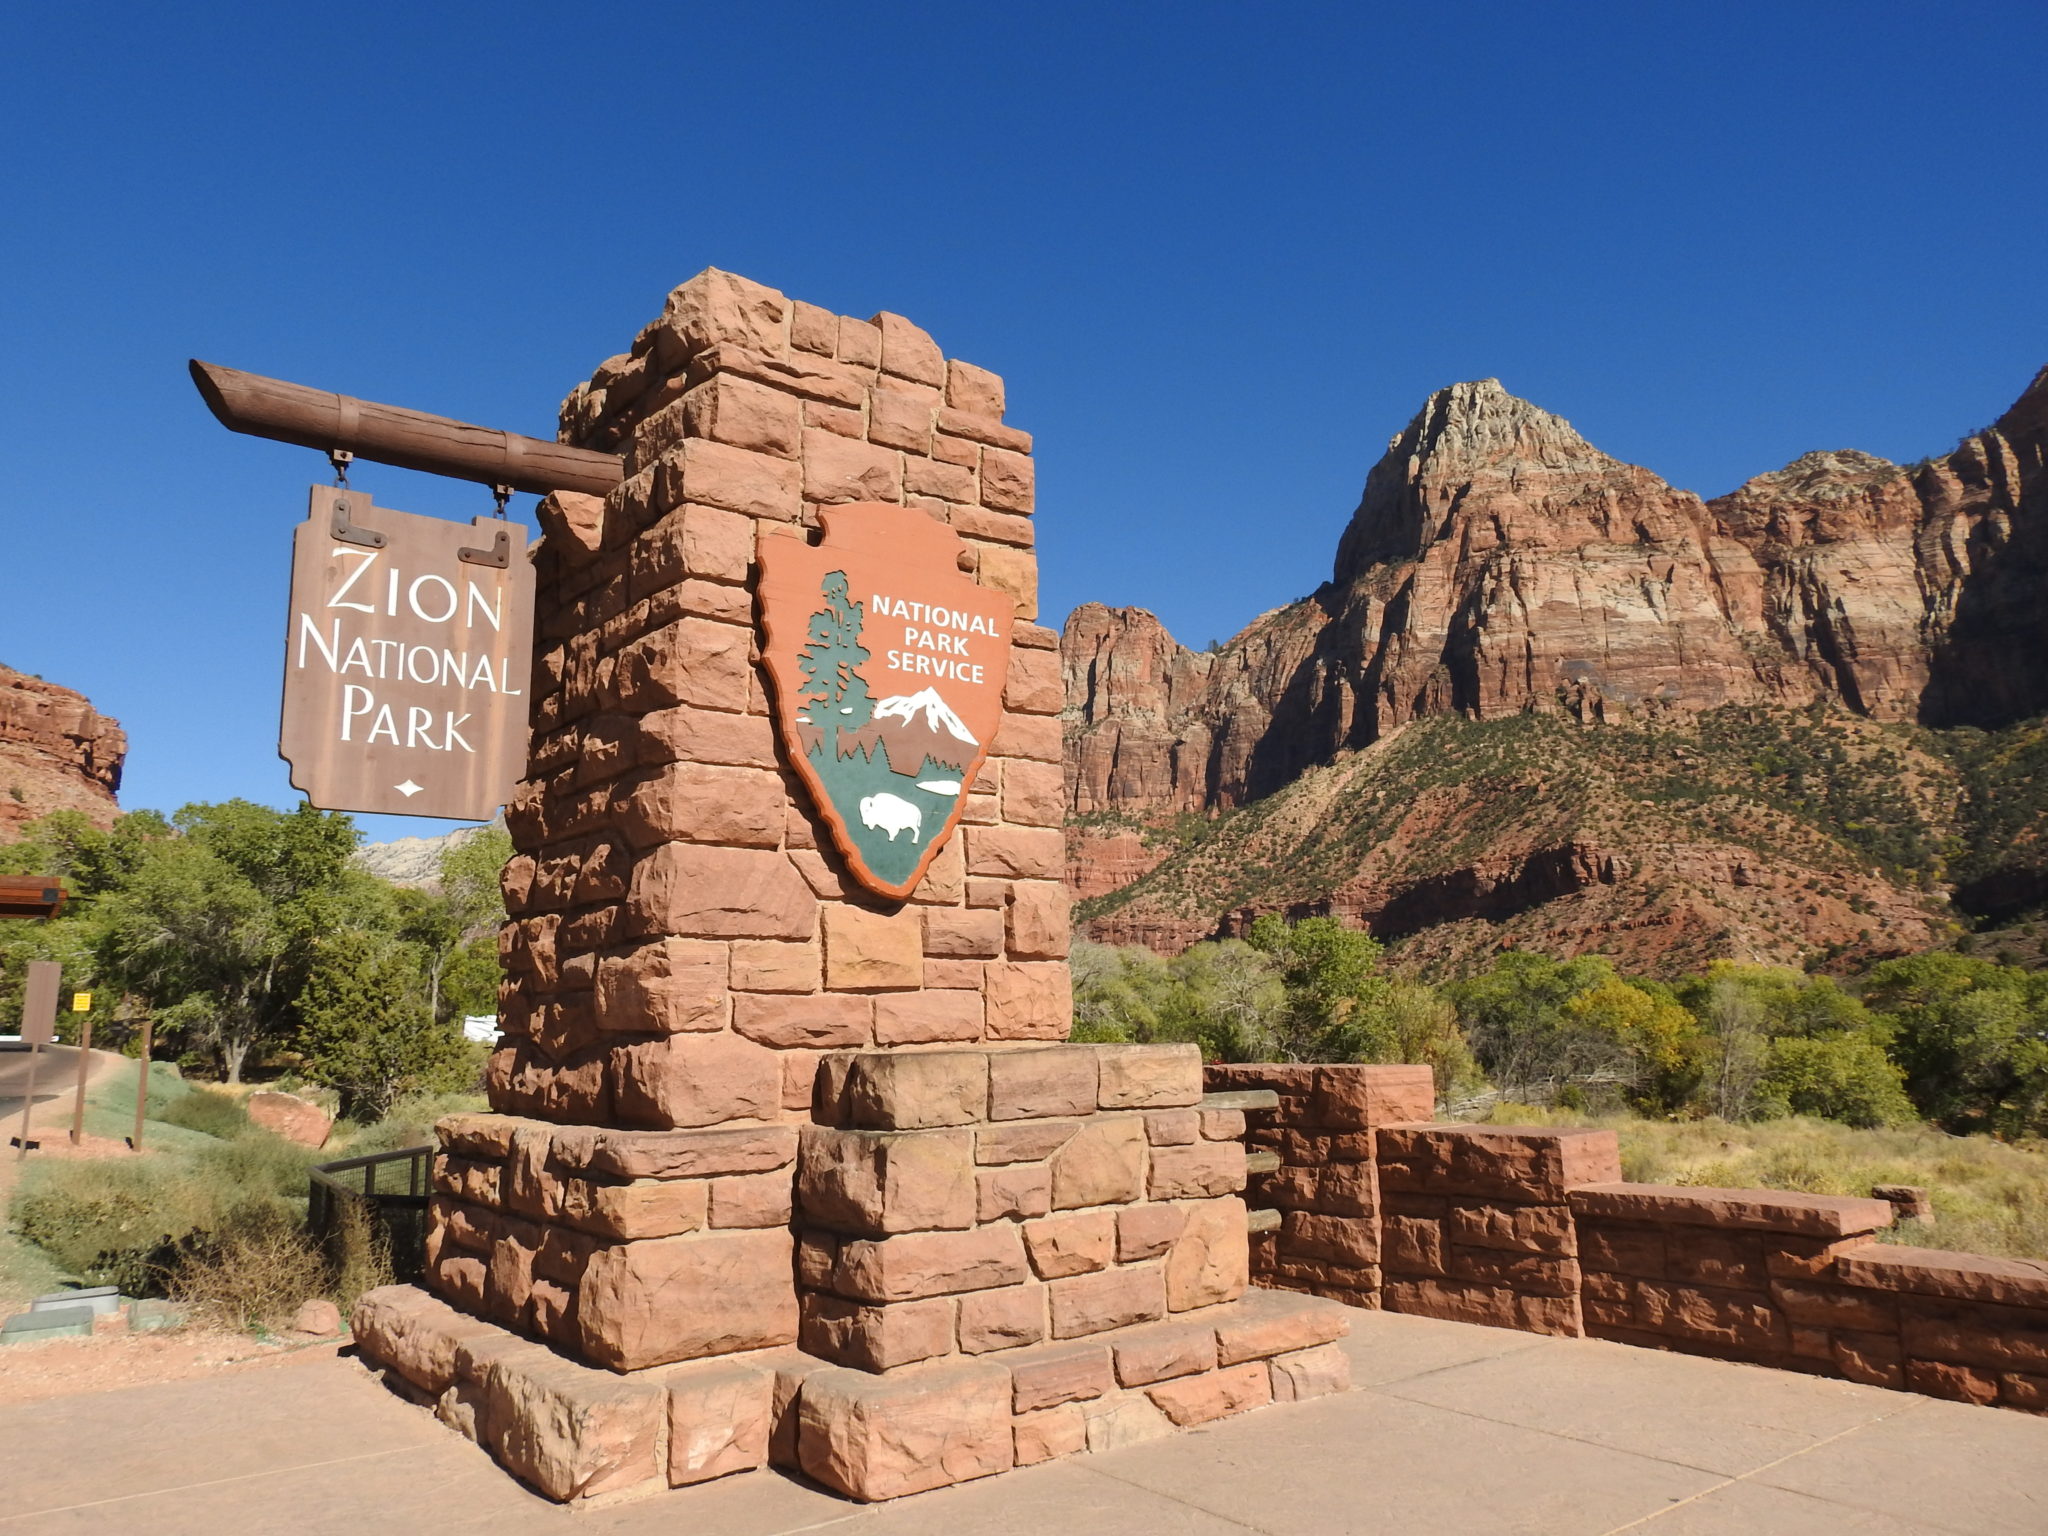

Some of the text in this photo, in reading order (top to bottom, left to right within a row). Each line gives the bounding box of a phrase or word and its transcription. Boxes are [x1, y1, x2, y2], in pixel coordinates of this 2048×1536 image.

[327, 546, 502, 632] ZION
[872, 594, 1000, 638] NATIONAL
[299, 612, 522, 696] NATIONAL
[887, 650, 984, 685] SERVICE
[904, 627, 970, 657] PARK
[341, 684, 476, 753] PARK
